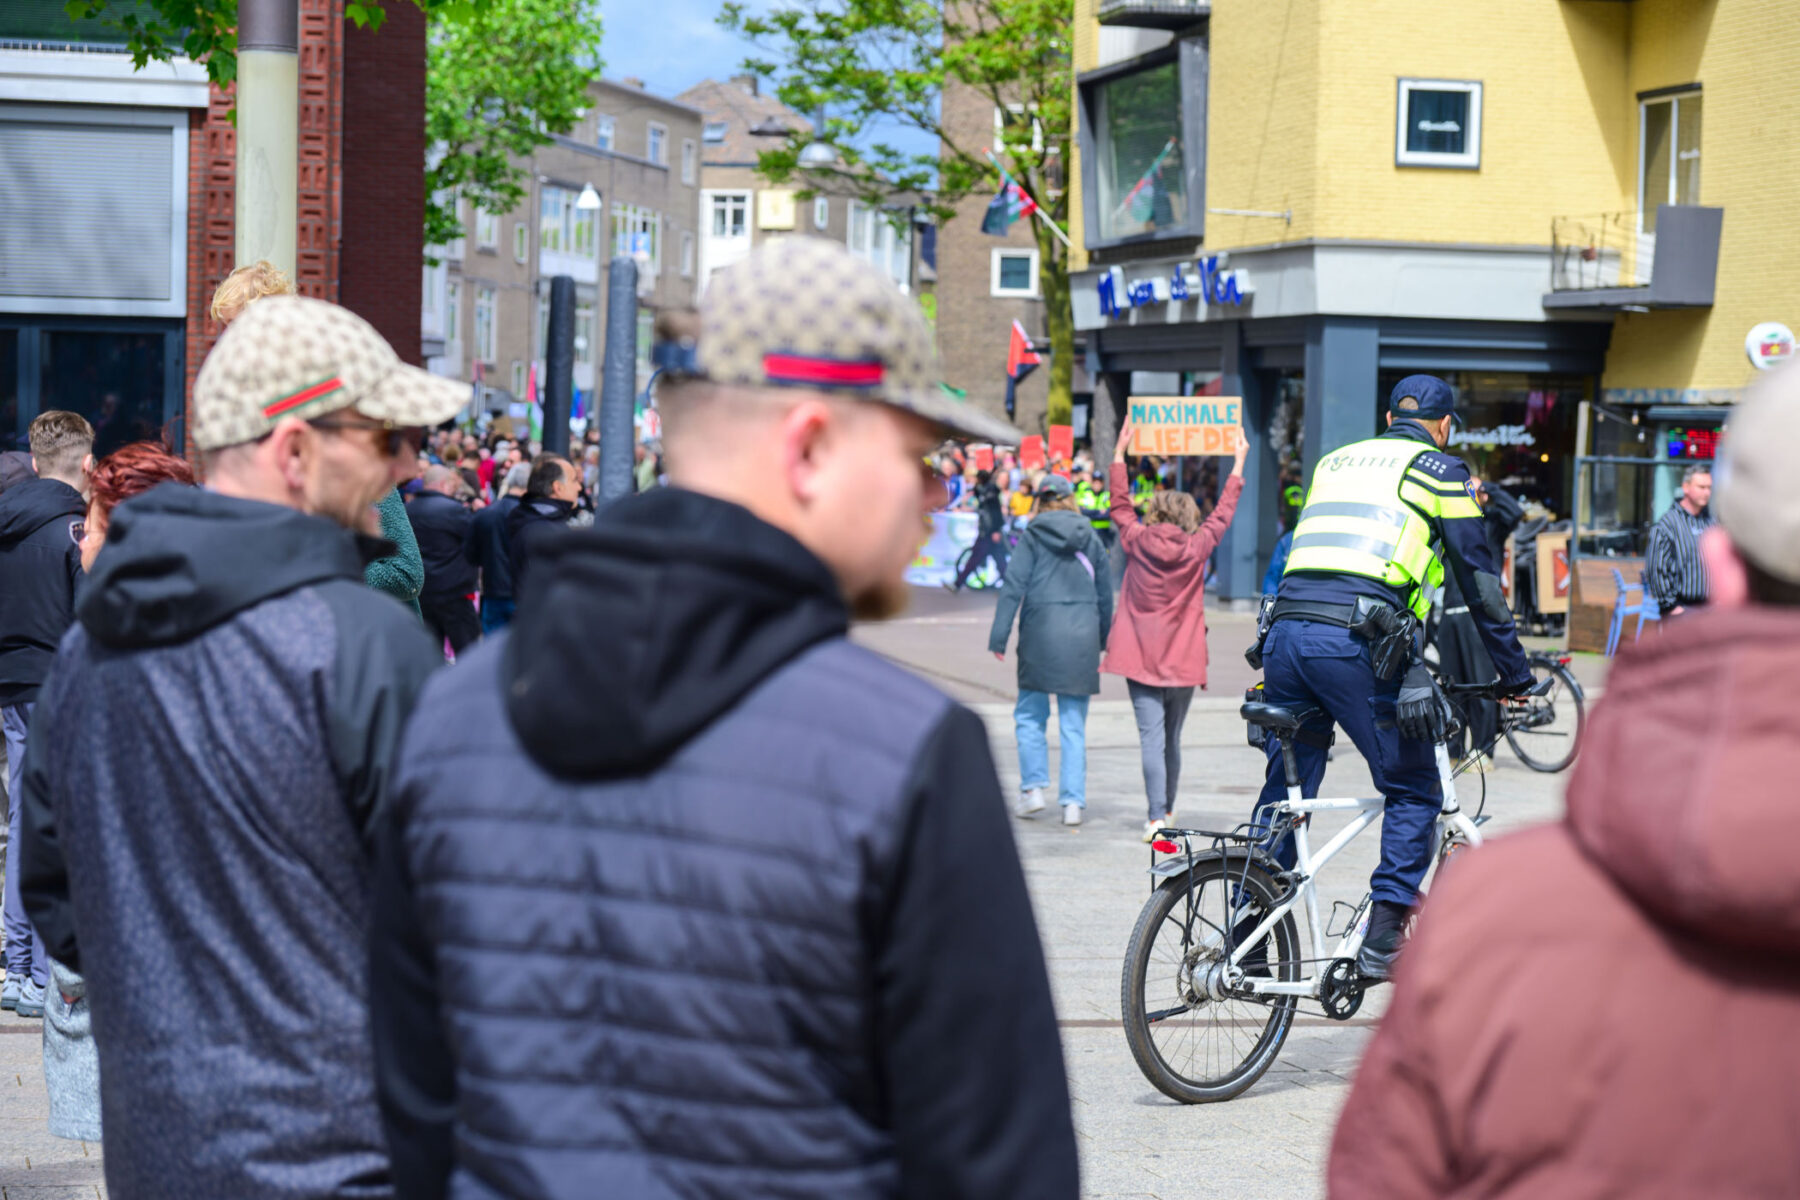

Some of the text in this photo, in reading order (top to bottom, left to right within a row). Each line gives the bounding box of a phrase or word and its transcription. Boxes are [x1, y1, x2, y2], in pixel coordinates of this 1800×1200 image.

[1131, 401, 1237, 425] MAXIMALE
[1133, 426, 1236, 454] LIEFDE
[1320, 456, 1400, 471] POLITIE
